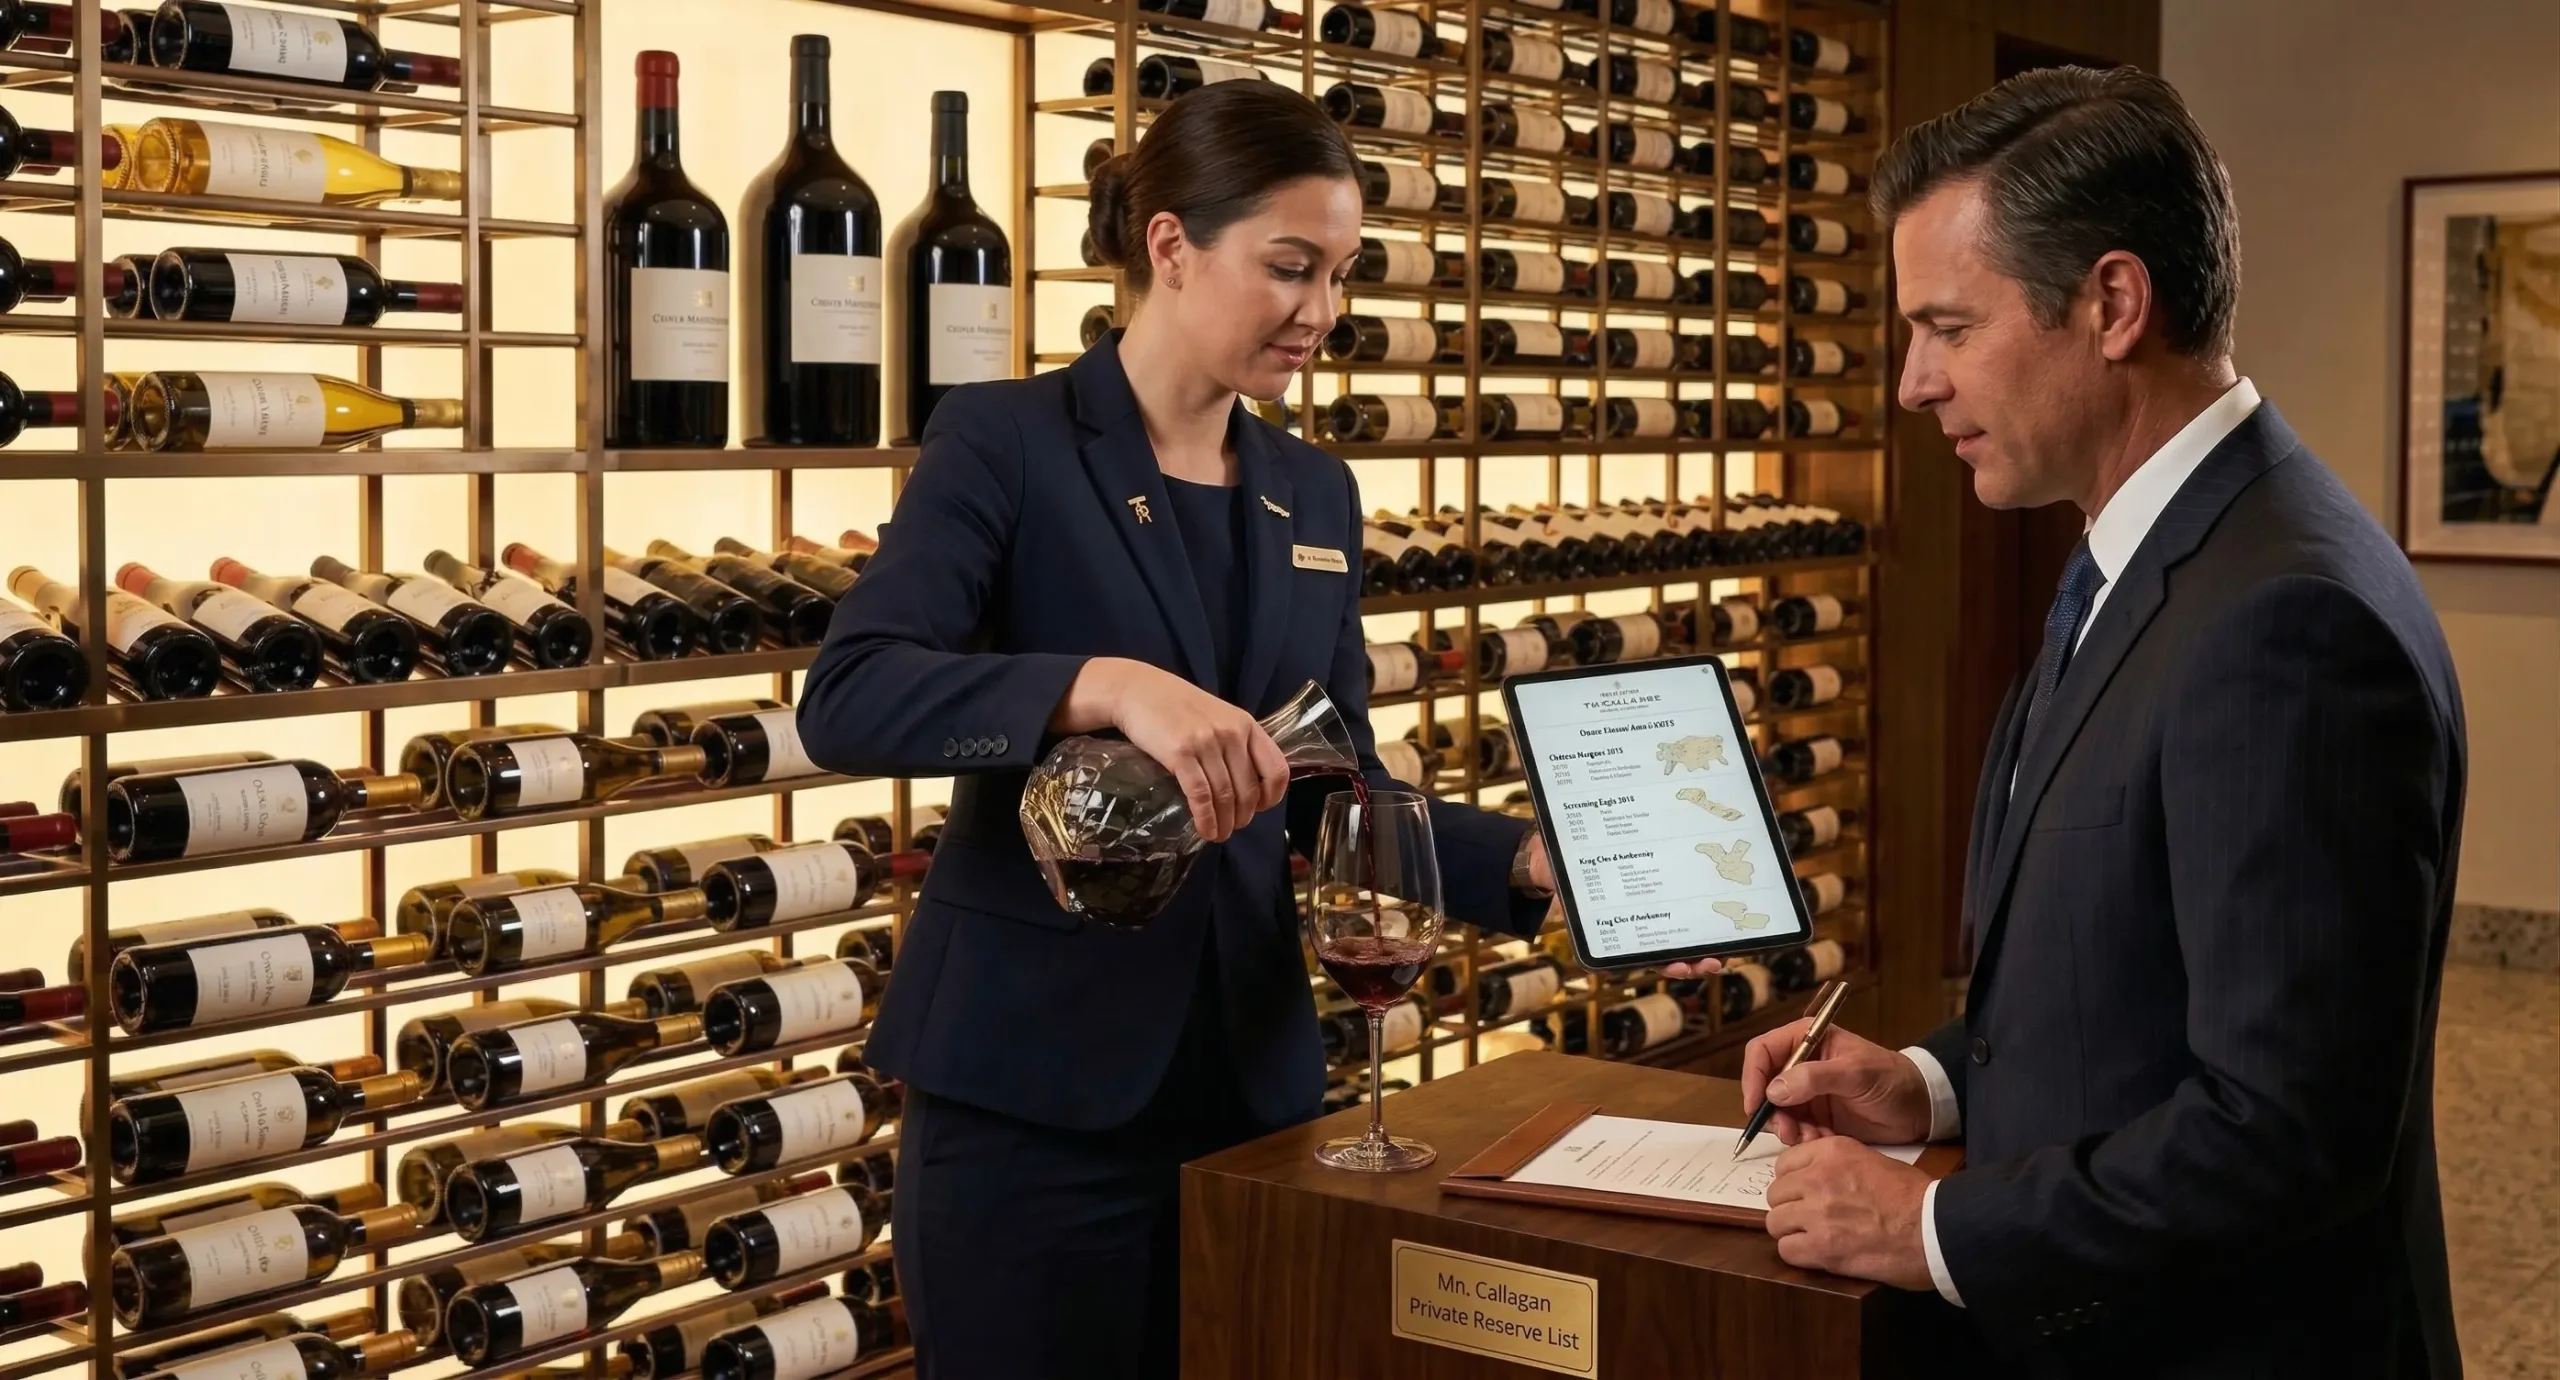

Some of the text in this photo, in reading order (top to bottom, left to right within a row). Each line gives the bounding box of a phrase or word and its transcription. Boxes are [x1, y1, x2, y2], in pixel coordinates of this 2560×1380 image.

[1438, 1272, 1551, 1313] Mn. Callagan
[1410, 1297, 1580, 1350] Private Reserve List
